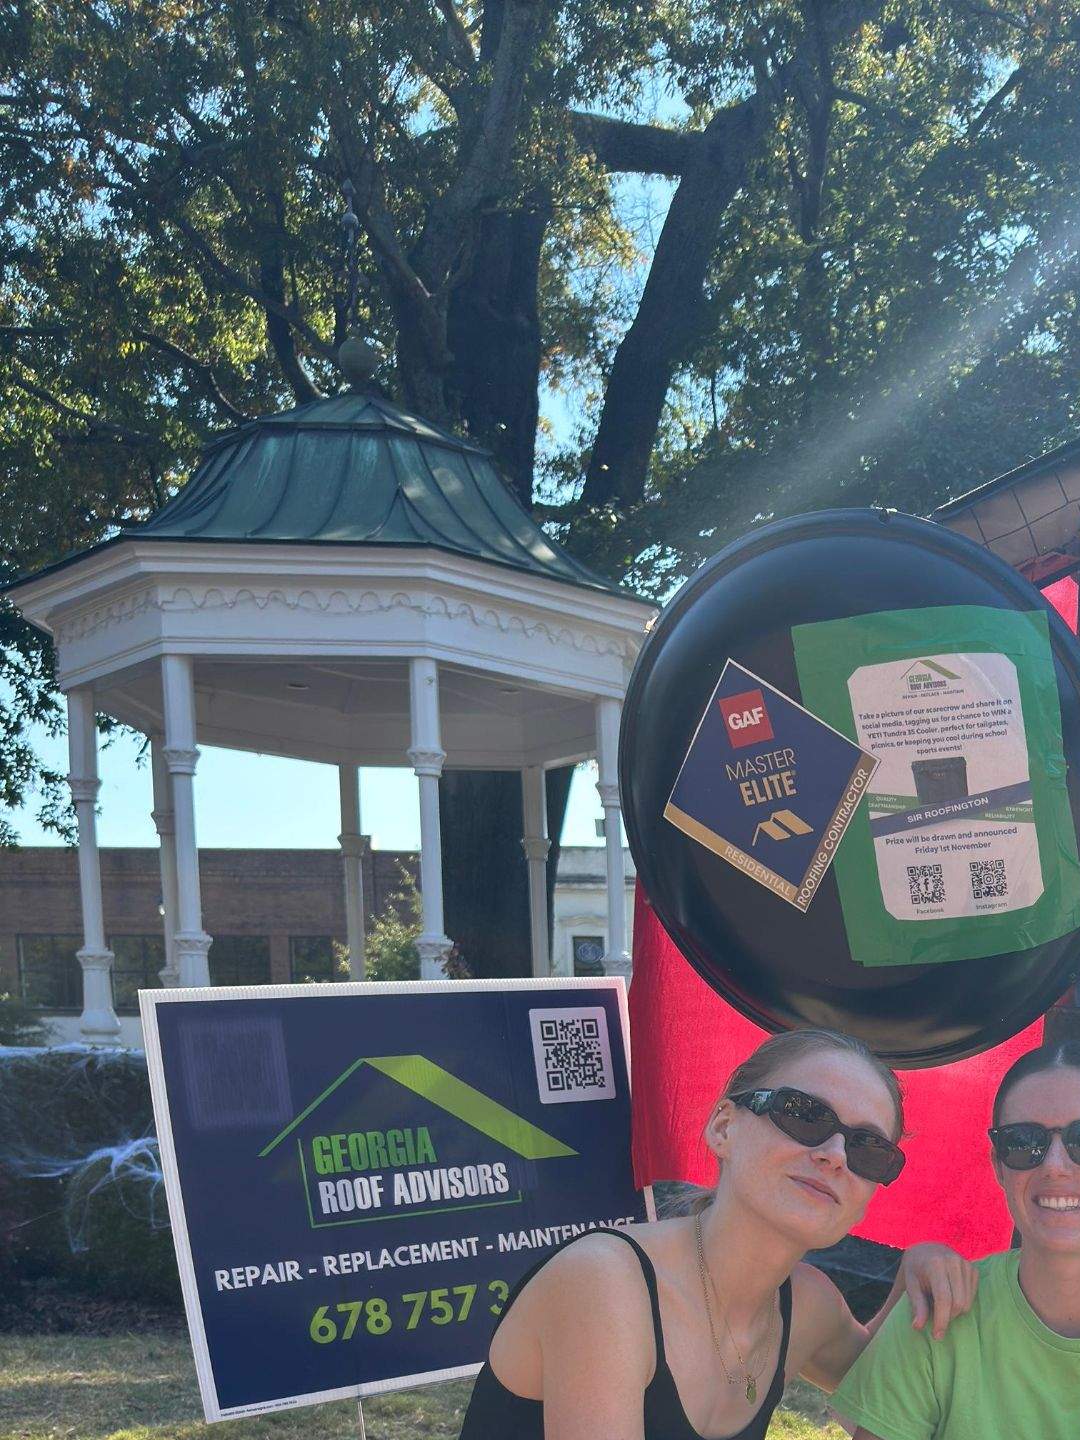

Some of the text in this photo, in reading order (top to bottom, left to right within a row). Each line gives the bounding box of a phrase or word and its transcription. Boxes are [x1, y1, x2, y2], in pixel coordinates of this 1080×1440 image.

[728, 706, 763, 731] GAF
[858, 713, 875, 721] Take
[881, 710, 904, 720] picture
[926, 705, 960, 714] scarecrow
[961, 702, 975, 710] and
[976, 700, 995, 708] share
[862, 722, 881, 730] social
[905, 718, 931, 728] tagging
[940, 714, 951, 722] for
[957, 712, 981, 720] chance
[991, 709, 1006, 717] WIN
[867, 732, 883, 740] YETI
[883, 729, 907, 738] Tundra
[940, 723, 965, 733] perfect
[905, 737, 931, 747] keeping
[931, 736, 945, 745] you
[946, 734, 960, 742] cool
[961, 731, 984, 741] during
[984, 729, 1008, 737] school
[725, 747, 796, 781] MASTER
[917, 747, 938, 756] sports
[739, 770, 797, 807] ELITE
[907, 797, 989, 824] SIR ROOFINGTON
[797, 767, 870, 907] ROOFING CONTRACTOR
[906, 836, 920, 844] will
[921, 834, 931, 843] be
[931, 833, 957, 841] drawn
[958, 831, 972, 839] and
[973, 827, 1018, 838] announced
[914, 846, 939, 855] Friday
[951, 842, 991, 852] November
[724, 845, 791, 897] RESIDENTIAL
[976, 902, 1007, 910] Instagram
[312, 1126, 436, 1175] GEORGIA
[318, 1162, 510, 1214] ROOF ADVISORS
[214, 1260, 303, 1292] REPAIR
[324, 1237, 480, 1277] REPLACEMENT
[309, 1299, 393, 1345] 678
[401, 1282, 477, 1330] 757
